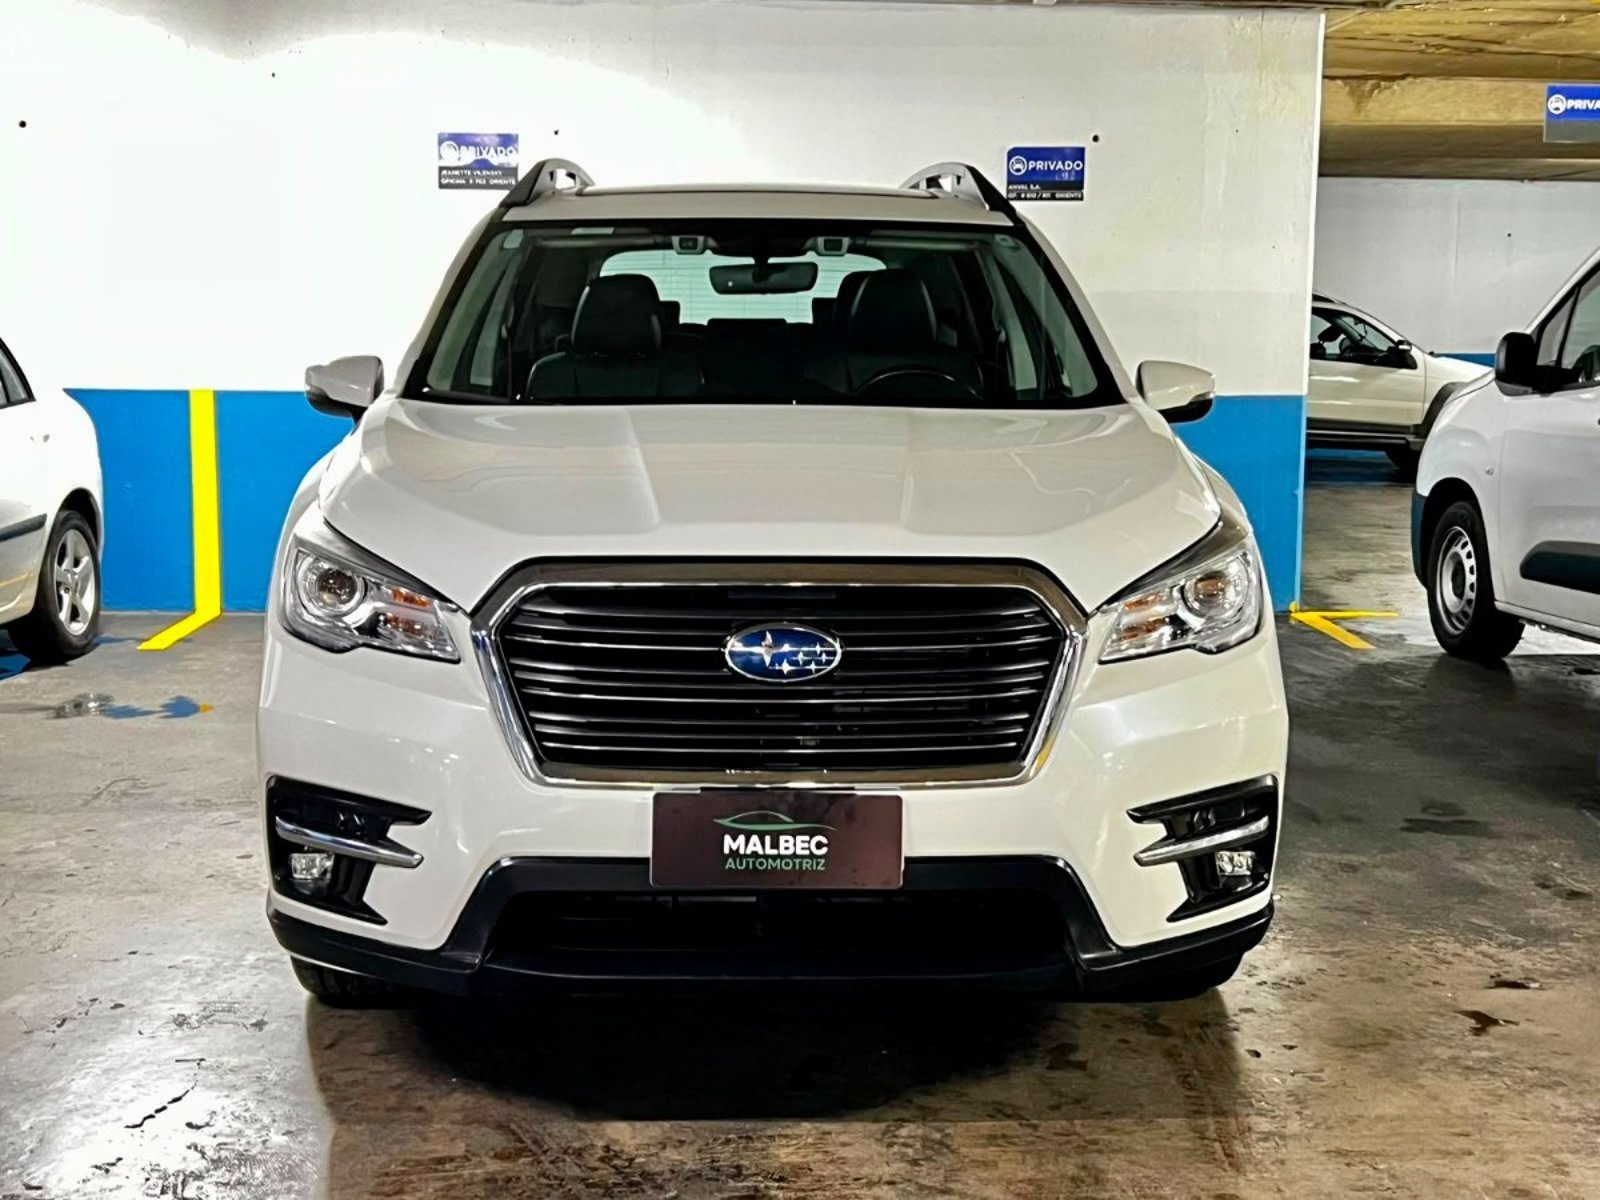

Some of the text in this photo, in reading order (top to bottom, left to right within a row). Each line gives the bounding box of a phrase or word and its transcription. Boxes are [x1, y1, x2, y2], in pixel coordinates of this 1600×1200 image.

[460, 146, 517, 157] PRIVADO
[1028, 161, 1083, 171] PRIVADO
[723, 834, 829, 856] MALBEC
[725, 857, 826, 871] AUTOMOTRIZ
